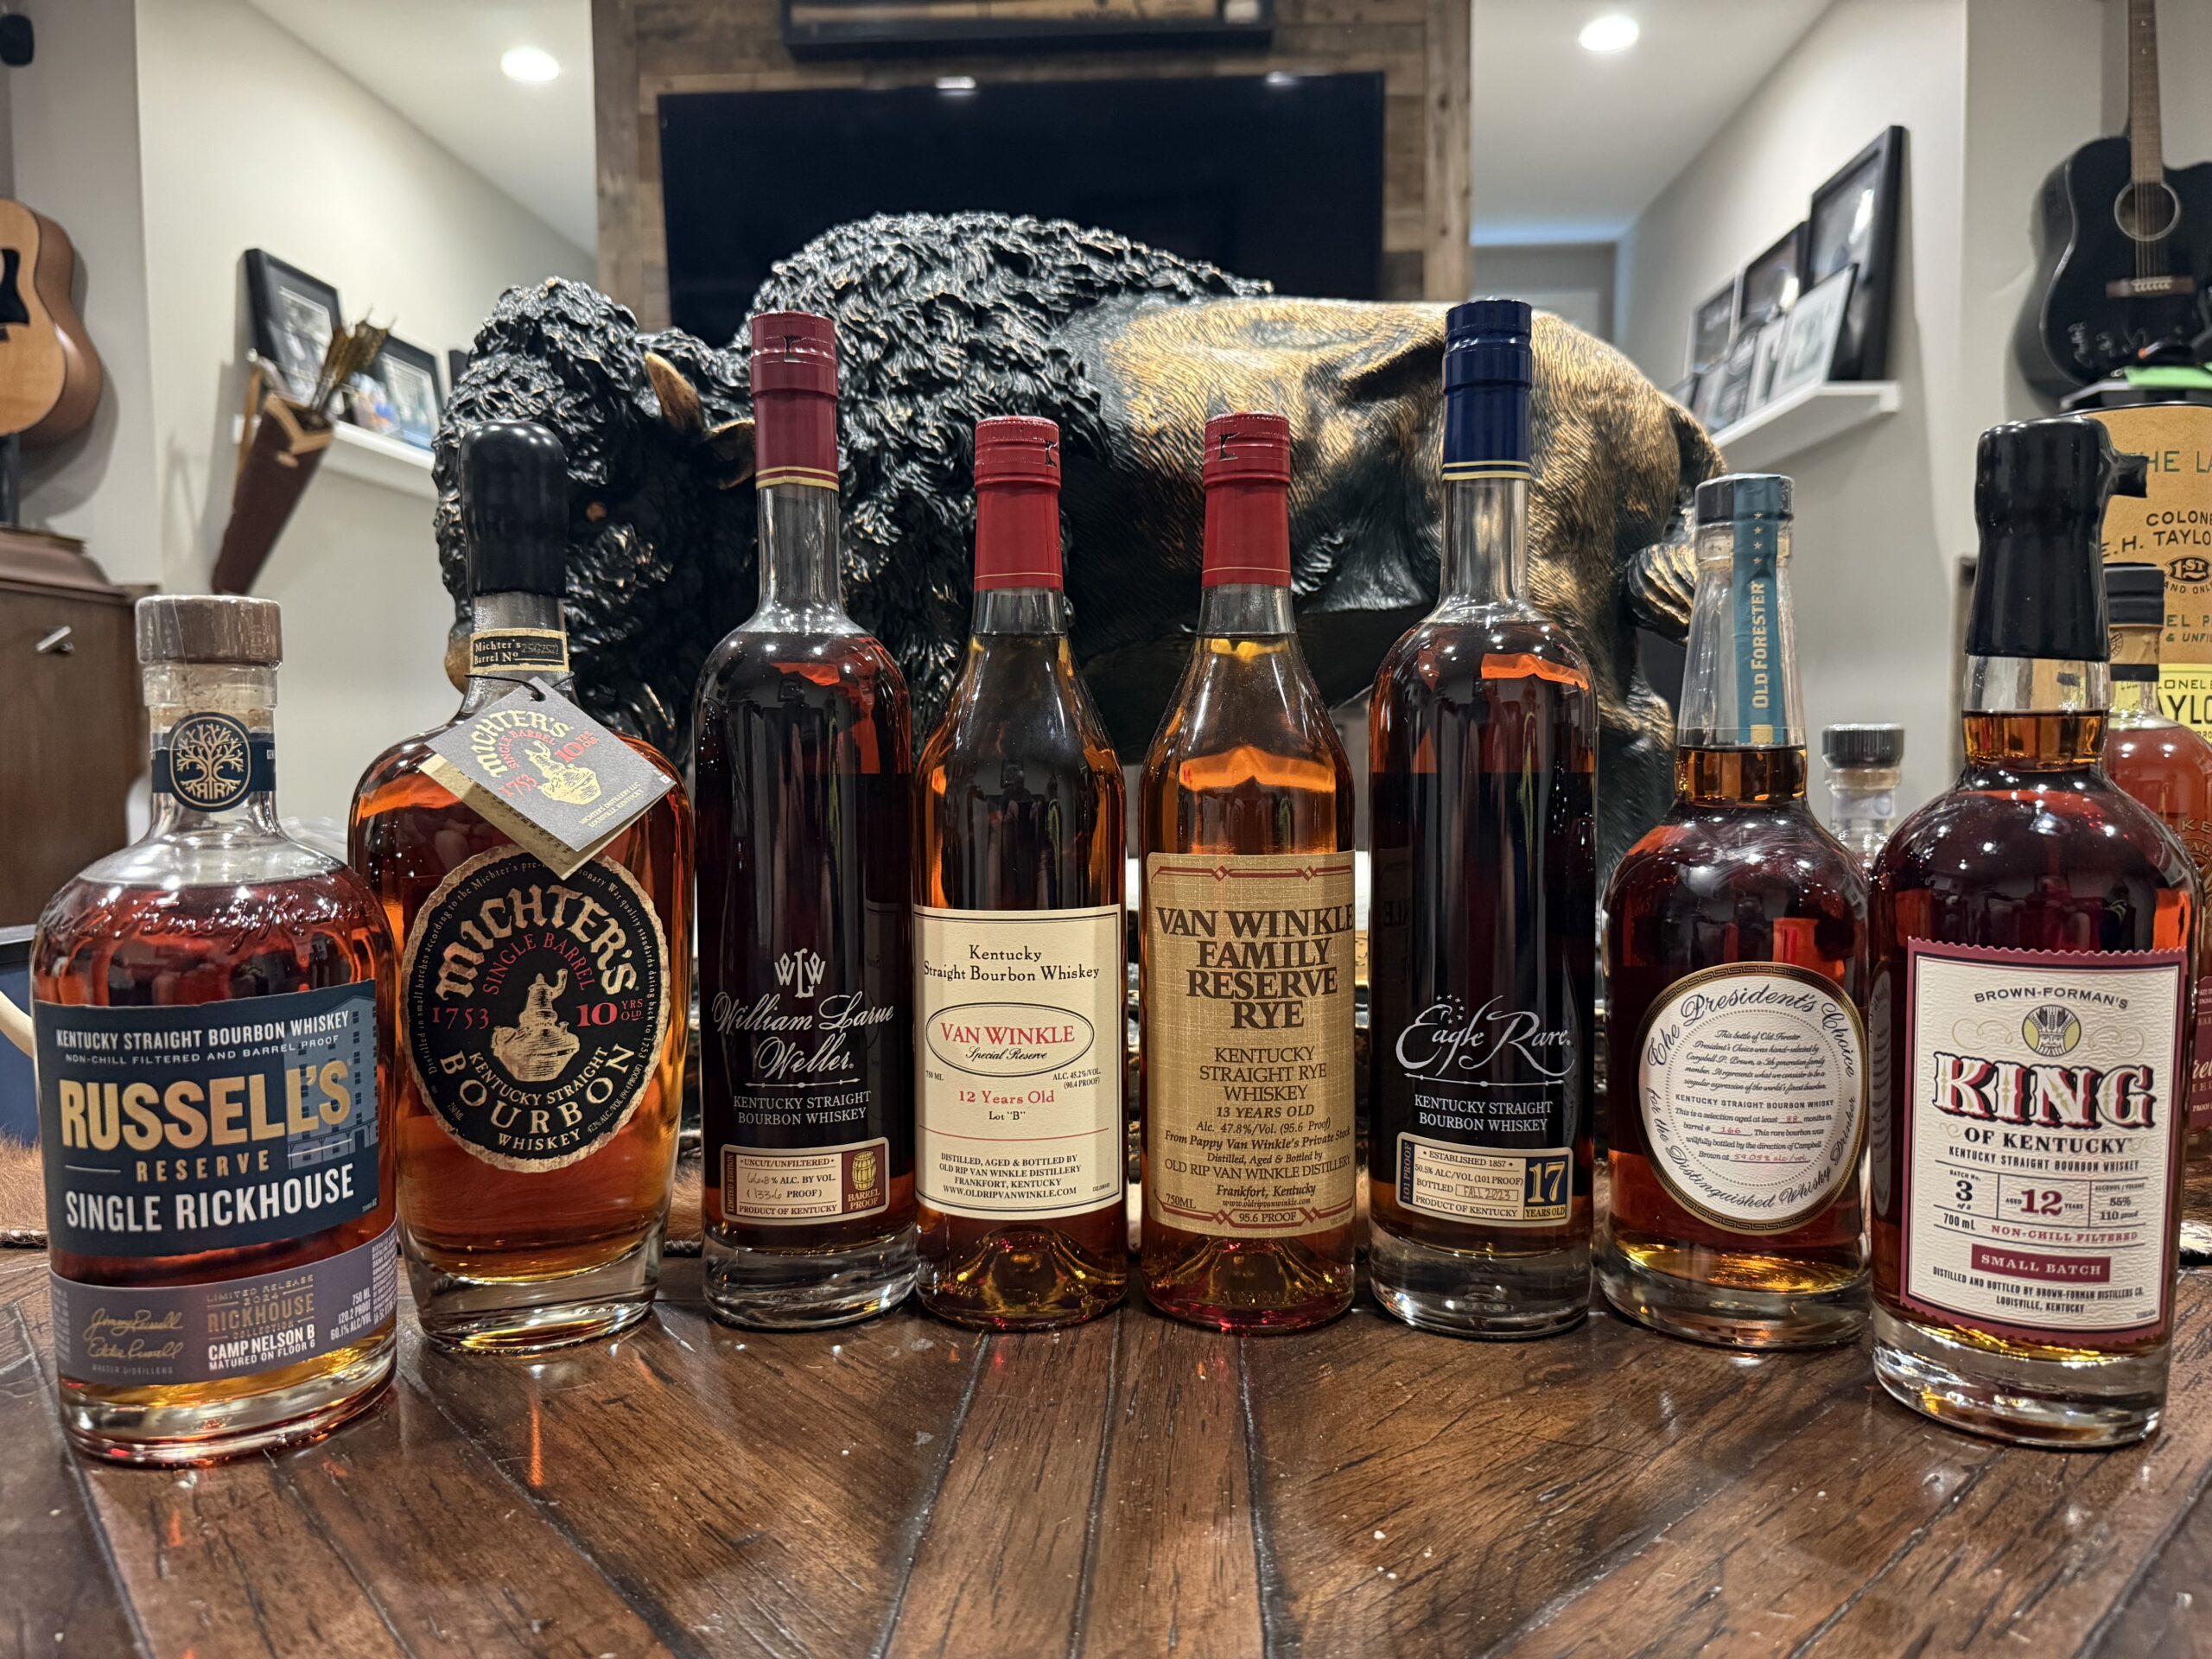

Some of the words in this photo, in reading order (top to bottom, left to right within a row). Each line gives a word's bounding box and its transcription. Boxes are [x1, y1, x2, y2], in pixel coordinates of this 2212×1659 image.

[2126, 451, 2180, 473] HE
[1751, 582, 1767, 669] FORESTER
[475, 639, 521, 652] Michter's
[1752, 671, 1769, 709] OLD
[470, 709, 571, 778] MICHTER'S
[499, 773, 537, 799] 1753
[470, 864, 518, 890] Michter's
[458, 888, 472, 900] the
[608, 882, 621, 899] War
[449, 901, 457, 910] to
[620, 900, 641, 926] quality
[426, 912, 452, 952] according
[1156, 908, 1218, 938] VAN
[1224, 903, 1353, 939] WINKLE
[435, 884, 639, 1001] MICHTER'S
[638, 928, 653, 964] standards
[969, 944, 1041, 962] Kentucky
[1197, 938, 1332, 969] FAMILY
[416, 955, 429, 988] batches
[483, 933, 537, 995] SINGLE
[543, 932, 596, 991] BARREL
[924, 961, 966, 980] Straight
[970, 965, 1035, 982] Bourbon
[1040, 965, 1100, 980] Whiskey
[647, 966, 657, 998] dating
[1187, 968, 1338, 1000] RESERVE
[413, 991, 423, 1015] small
[621, 999, 643, 1009] YRS
[1974, 987, 2128, 1009] BROWN-FORMAN'S
[433, 1007, 489, 1029] 1753
[576, 1002, 618, 1027] 10
[620, 1011, 644, 1020] OLD
[647, 1001, 657, 1020] back
[712, 991, 812, 1034] William
[819, 991, 893, 1033] Larue
[1230, 1001, 1304, 1029] RYE
[57, 1029, 118, 1050] KENTUCKY
[124, 1030, 202, 1050] STRAIGHT
[209, 1021, 285, 1046] BOURBON
[289, 1010, 349, 1037] WHISKEY
[418, 1020, 423, 1029] in
[645, 1024, 652, 1033] to
[941, 1023, 980, 1044] VAN
[984, 1025, 1075, 1045] WINKLE
[1395, 995, 1503, 1077] Eagle
[1459, 1010, 1574, 1077] Rare
[1648, 1025, 1681, 1066] The
[1681, 984, 1815, 1027] President's
[1821, 1001, 1854, 1077] Choice
[66, 1053, 127, 1065] NON-CHILL
[132, 1054, 200, 1065] FILTERED
[207, 1051, 236, 1061] AND
[243, 1044, 296, 1058] BARREL
[302, 1035, 339, 1049] PROOF
[417, 1033, 437, 1074] Distilled
[639, 1038, 655, 1058] 1753
[758, 1033, 849, 1079] Weller
[966, 1047, 1006, 1063] Special
[1007, 1049, 1048, 1059] Reserve
[1214, 1046, 1314, 1065] KENTUCKY
[469, 1052, 542, 1105] KENTUCKY
[546, 1047, 608, 1104] STRAIGHT
[1199, 1065, 1294, 1084] STRAIGHT
[1298, 1063, 1327, 1078] RYE
[441, 1044, 635, 1135] BOURBON
[734, 1096, 803, 1109] KENTUCKY
[807, 1090, 871, 1108] STRAIGHT
[959, 1090, 976, 1102] 12
[982, 1090, 1023, 1103] Years
[1028, 1090, 1054, 1103] Old
[1224, 1085, 1308, 1102] WHISKEY
[1932, 1052, 2155, 1129] KING
[60, 1060, 351, 1151] RUSSELL'S
[1217, 1107, 1230, 1117] 13
[1236, 1108, 1281, 1118] YEARS
[1287, 1104, 1314, 1116] OLD
[1414, 1094, 1485, 1114] KENTUCKY
[1489, 1101, 1553, 1115] STRAIGHT
[1675, 1094, 1718, 1106] KENTUCKY
[1721, 1100, 1763, 1109] STRAIGHT
[738, 1113, 801, 1125] BOURBON
[805, 1107, 866, 1124] WHISKEY
[989, 1111, 1004, 1120] Lot
[1419, 1112, 1484, 1130] BOURBON
[1488, 1119, 1548, 1131] WHISKEY
[499, 1127, 581, 1151] WHISKEY
[1645, 1087, 1662, 1114] for
[1655, 1118, 1669, 1142] the
[1666, 1145, 1776, 1207] Distinguished
[1778, 1168, 1832, 1204] Whisky
[1829, 1095, 1856, 1164] Drinker
[1964, 1127, 1994, 1143] OF
[2004, 1133, 2126, 1154] KENTUCKY
[136, 1150, 270, 1182] RESERVE
[1165, 1159, 1187, 1173] OLD
[1191, 1166, 1210, 1176] RIP
[1213, 1166, 1241, 1179] VAN
[1246, 1166, 1300, 1179] WINKLE
[1302, 1154, 1351, 1176] DISTILLERY
[1429, 1151, 1486, 1166] ESTABLISHED
[1949, 1146, 1996, 1163] KENTUCKY
[2000, 1154, 2050, 1172] STRAIGHT
[2055, 1159, 2099, 1172] BOURBON
[2103, 1160, 2139, 1172] WHISKEY
[944, 1185, 1077, 1199] WWW.OLDRIPVANWINKLE.COM
[1217, 1185, 1268, 1200] Frankfort,
[1273, 1184, 1316, 1197] Kentucky
[1528, 1161, 1565, 1203] 17
[1955, 1180, 1973, 1201] 3
[66, 1191, 162, 1232] SINGLE
[176, 1164, 354, 1230] RICKHOUSE
[849, 1189, 880, 1202] BARREL
[850, 1198, 878, 1210] PROOF
[1415, 1195, 1454, 1211] PRODUCT
[1470, 1205, 1517, 1217] KENTUCKY
[2109, 1198, 2131, 1206] 55%
[740, 1205, 776, 1215] PRODUCT
[791, 1205, 837, 1214] KENTUCKY
[1262, 1212, 1296, 1222] PROOF
[1944, 1213, 1960, 1227] 700
[1961, 1219, 1975, 1230] mL
[1992, 1225, 2072, 1242] NON-CHILL
[2076, 1232, 2138, 1243] FILTERED
[1981, 1254, 2039, 1271] SMALL
[2046, 1264, 2101, 1275] BATCH
[207, 1287, 257, 1303] LIMITED
[263, 1274, 314, 1293] RELEASE
[207, 1294, 315, 1332] RICKHOUSE
[208, 1342, 248, 1361] CAMP
[251, 1330, 298, 1353] NELSON
[307, 1324, 315, 1338] B
[209, 1355, 257, 1371] MATURED
[261, 1353, 274, 1362] ON
[278, 1342, 307, 1357] FLOOR
[309, 1340, 315, 1349] 6
